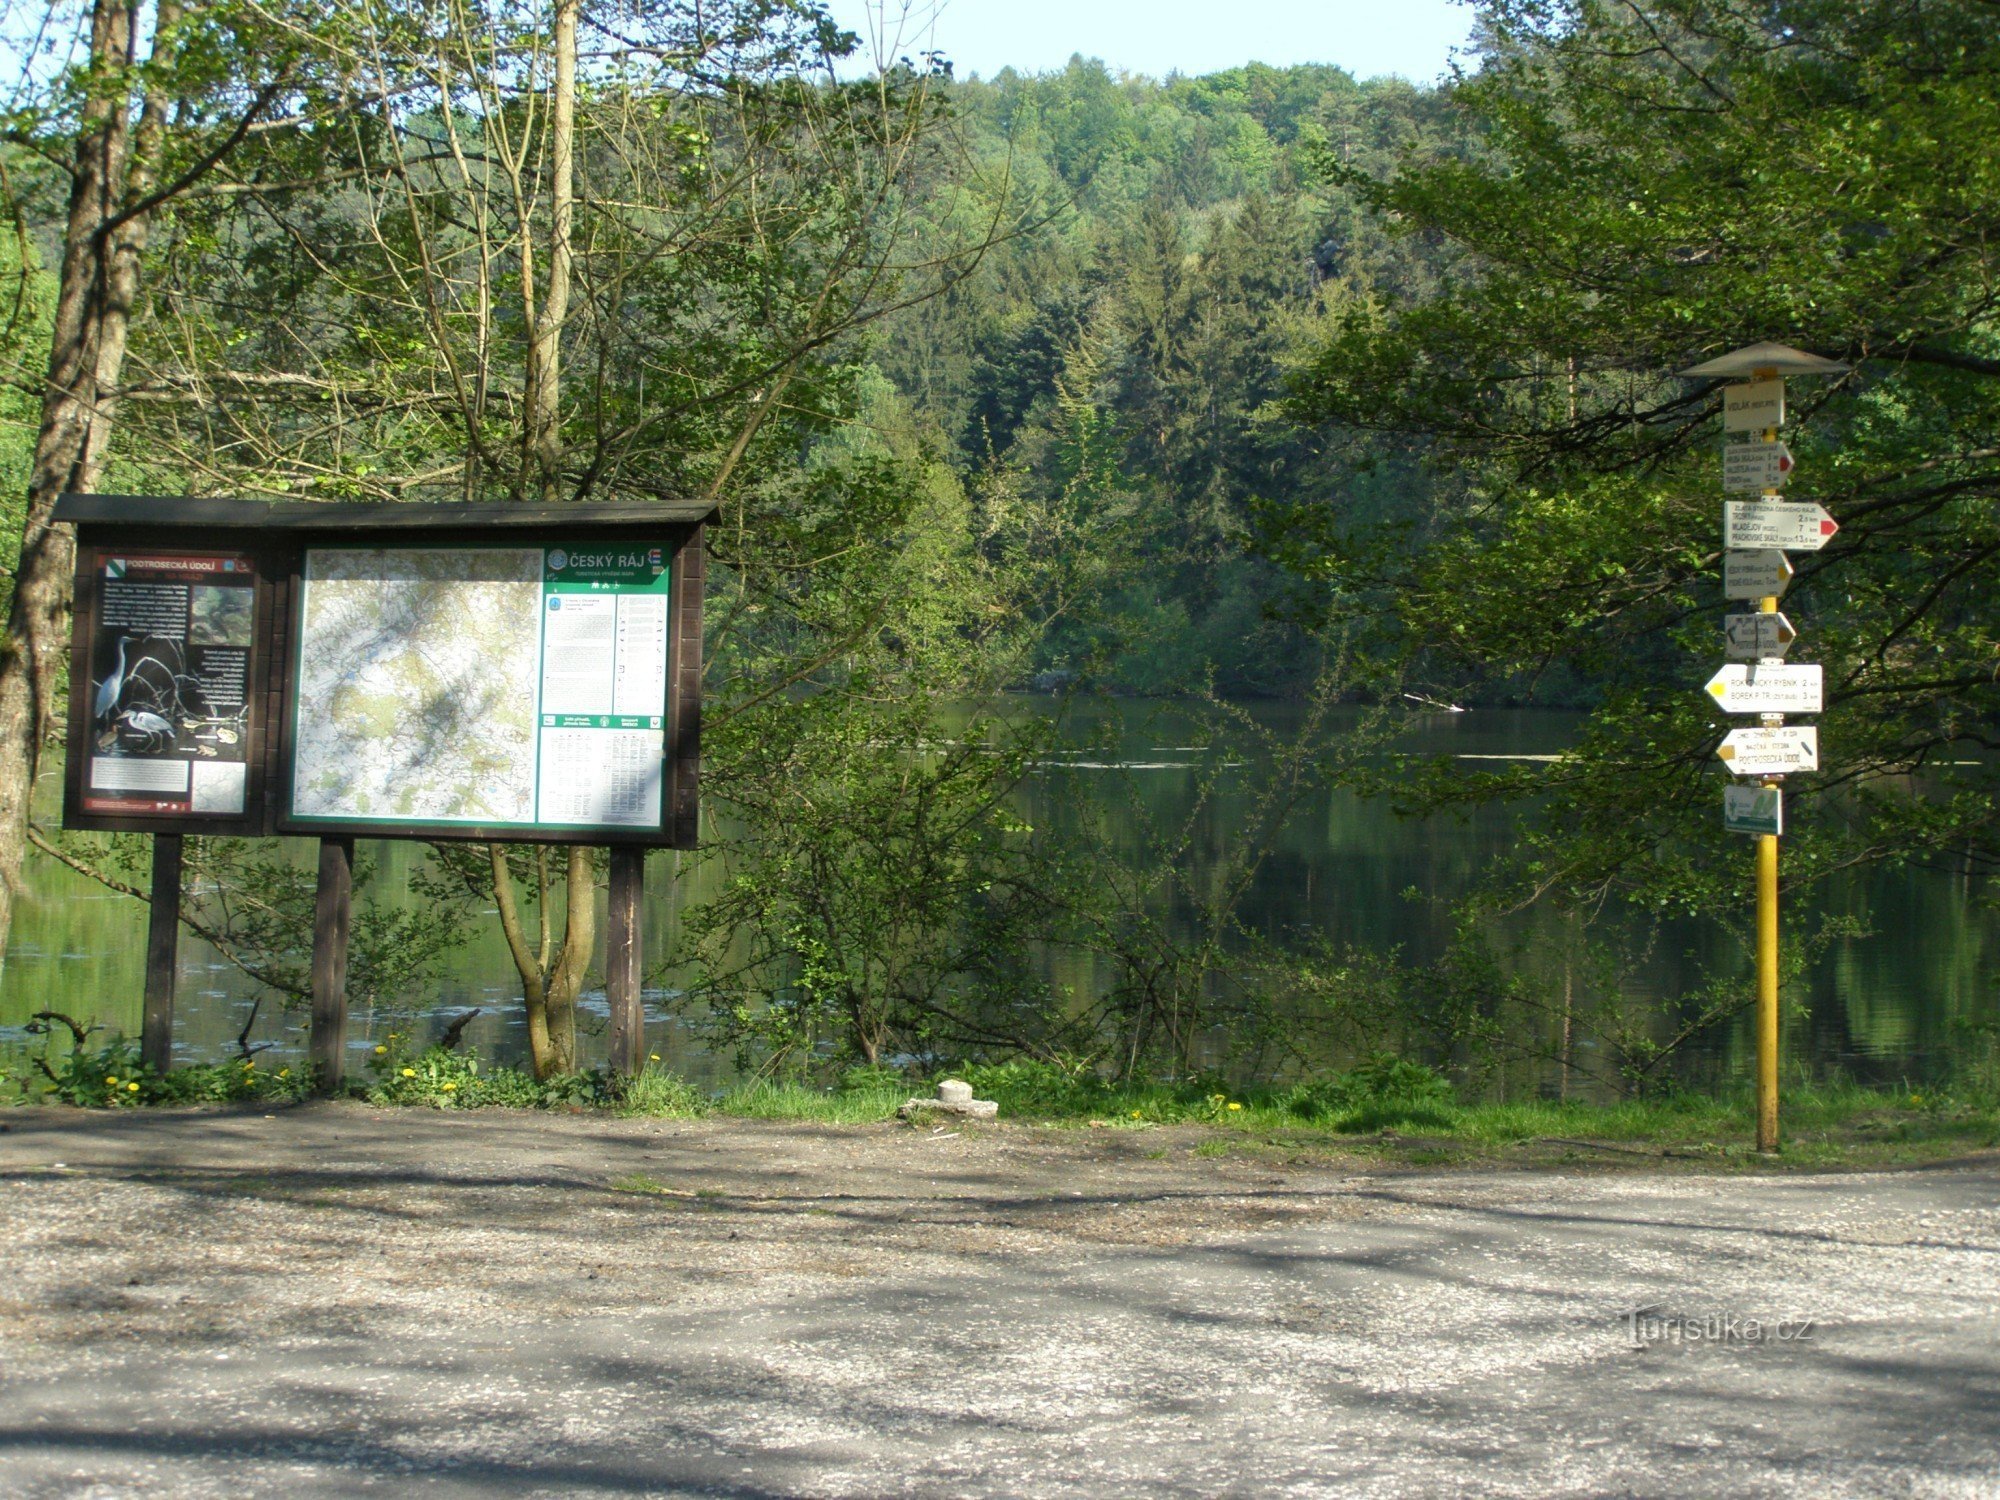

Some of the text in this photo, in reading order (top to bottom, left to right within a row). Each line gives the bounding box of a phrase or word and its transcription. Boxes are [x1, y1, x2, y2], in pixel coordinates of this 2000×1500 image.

[126, 559, 215, 571] PODTROSECKÁ ÚDOLÍ
[569, 552, 645, 568] ČESKÝ RÁJ
[1802, 692, 1808, 700] 3
